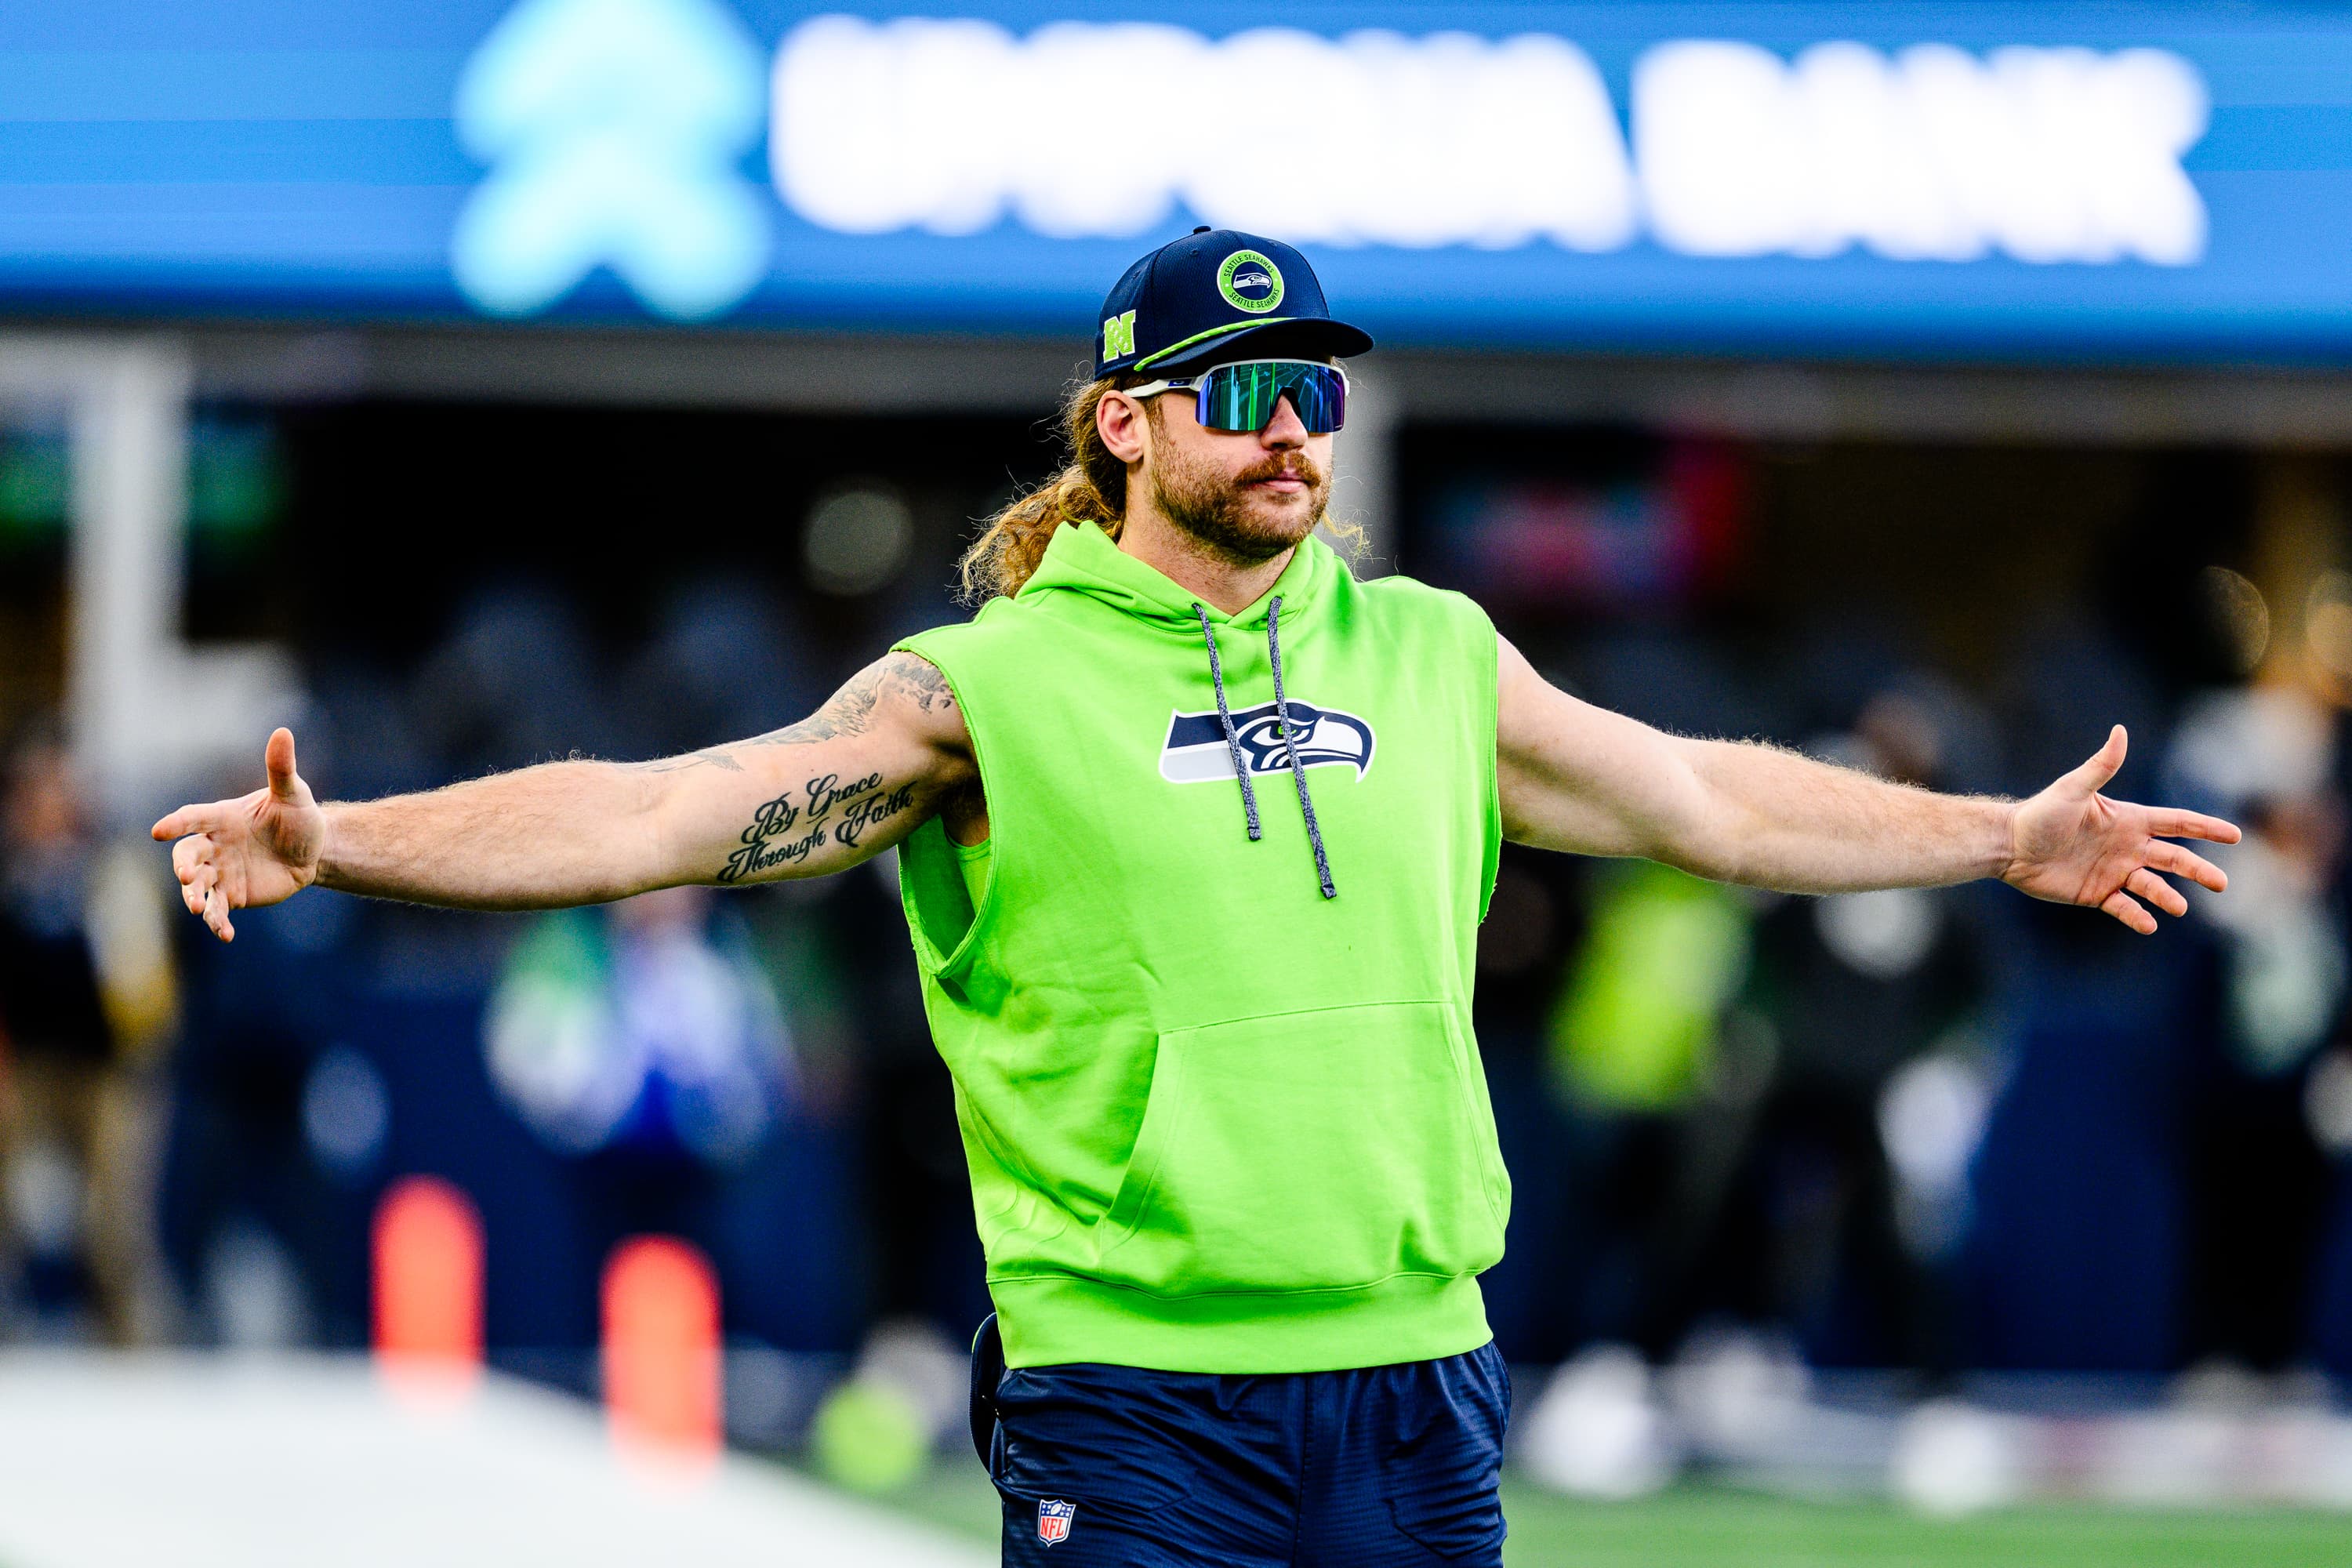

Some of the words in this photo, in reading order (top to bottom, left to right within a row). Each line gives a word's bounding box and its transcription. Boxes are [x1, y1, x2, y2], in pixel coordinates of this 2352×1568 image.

[1224, 256, 1243, 277] SEATTLE
[1244, 254, 1275, 273] SEAHAWKS
[1229, 292, 1254, 308] SEATTLE
[1256, 288, 1279, 308] SEAHAWKS
[741, 791, 800, 844] By
[806, 772, 884, 823] Grace
[717, 817, 829, 884] Through
[835, 781, 916, 848] Faith
[1040, 1517, 1064, 1539] NFL
